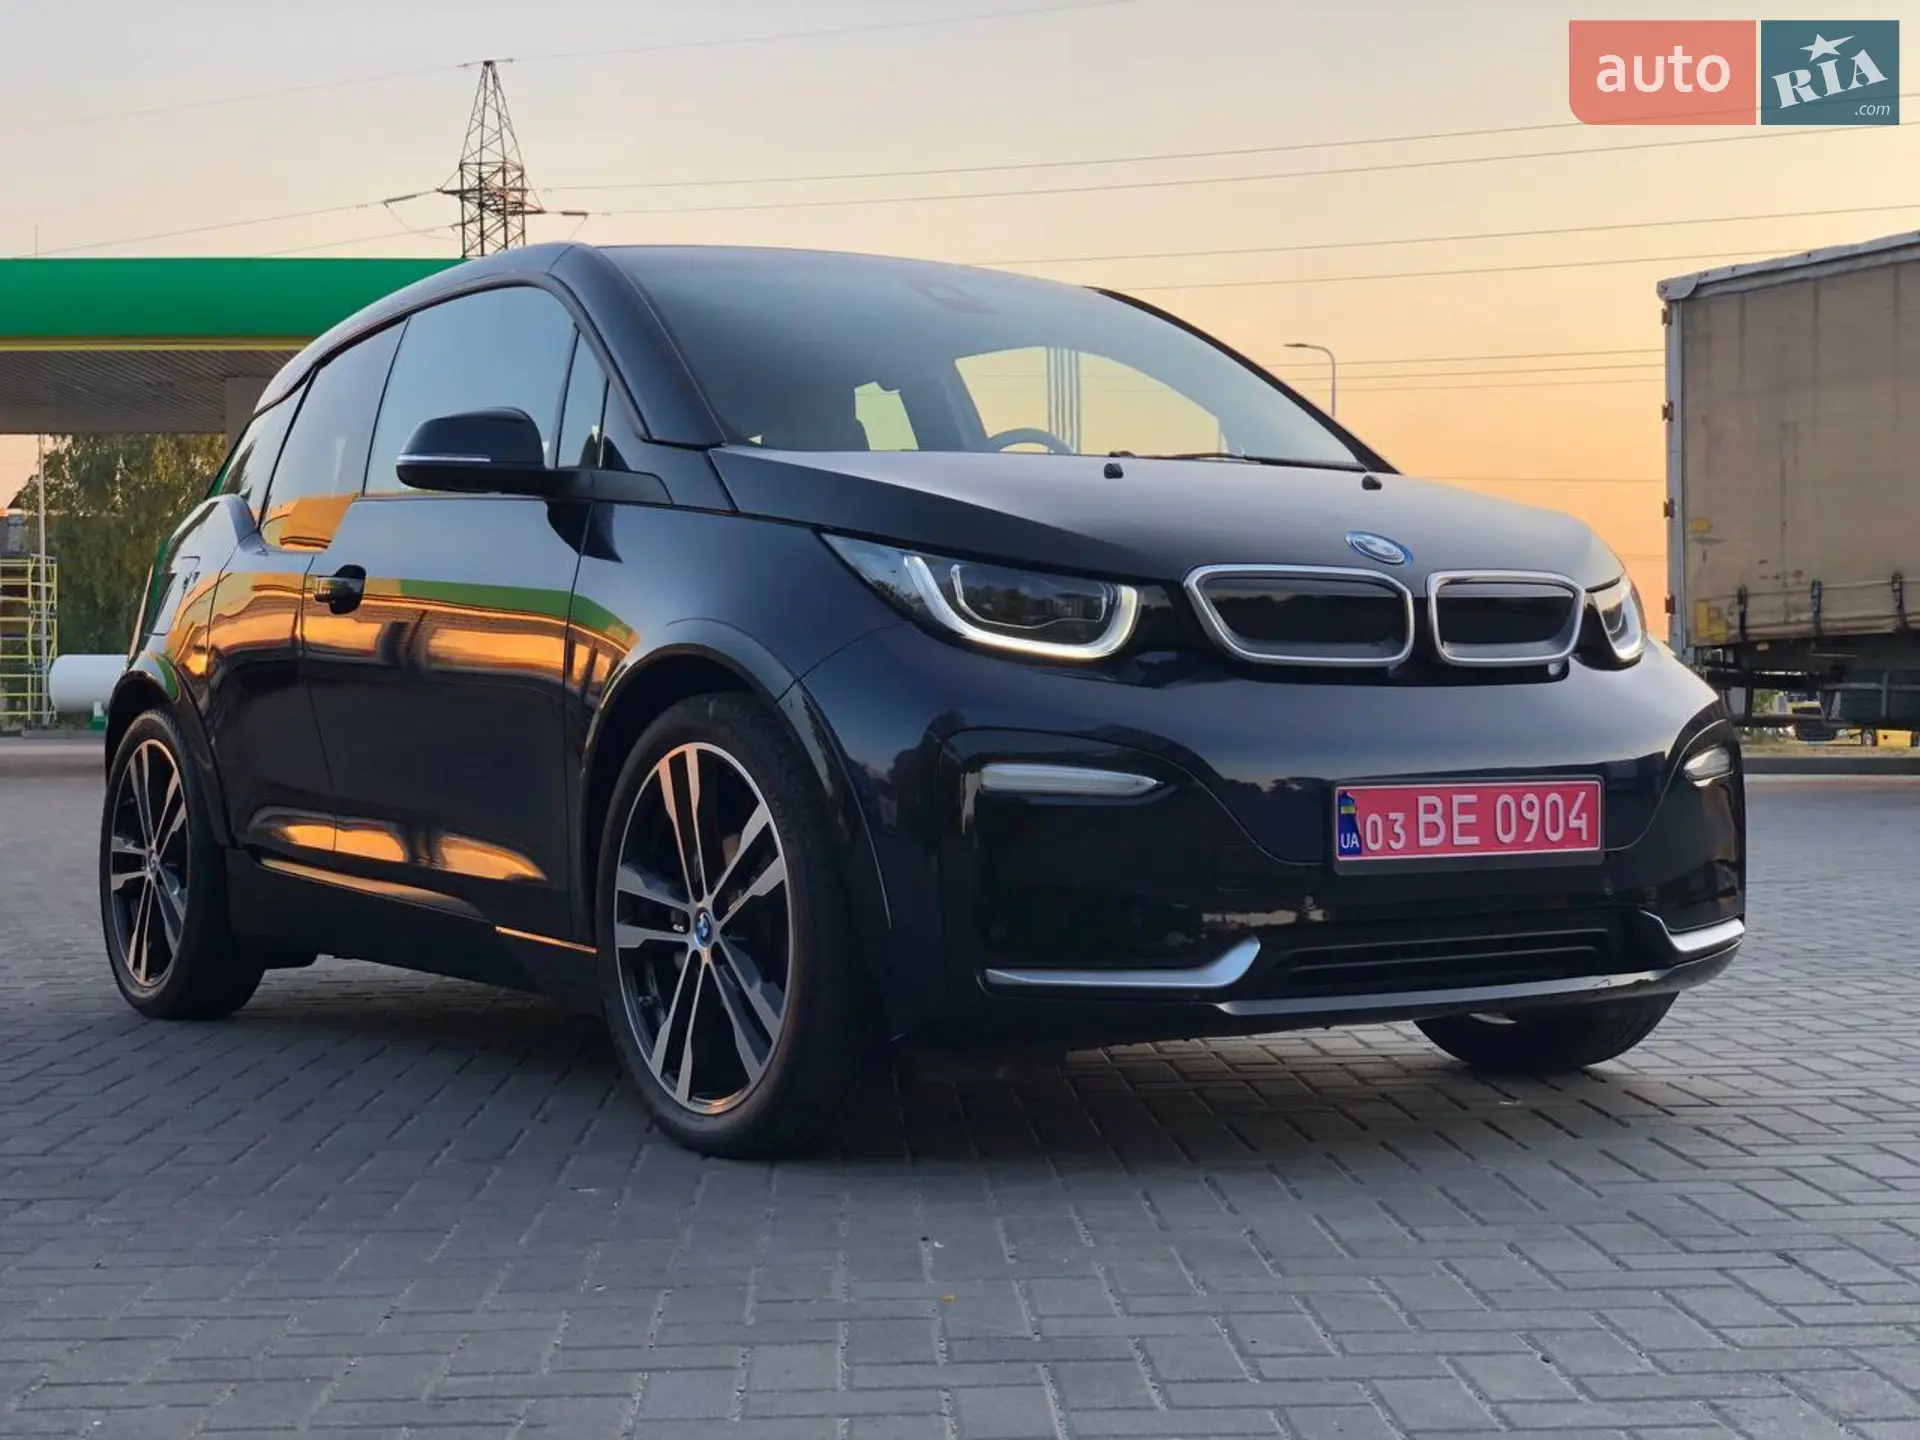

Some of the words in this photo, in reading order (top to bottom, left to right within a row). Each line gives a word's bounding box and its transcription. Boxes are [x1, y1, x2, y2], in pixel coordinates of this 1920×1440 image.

[1365, 813, 1406, 851] 03
[1418, 795, 1480, 847] BE
[1496, 791, 1588, 844] 0904
[1340, 832, 1360, 849] UA
